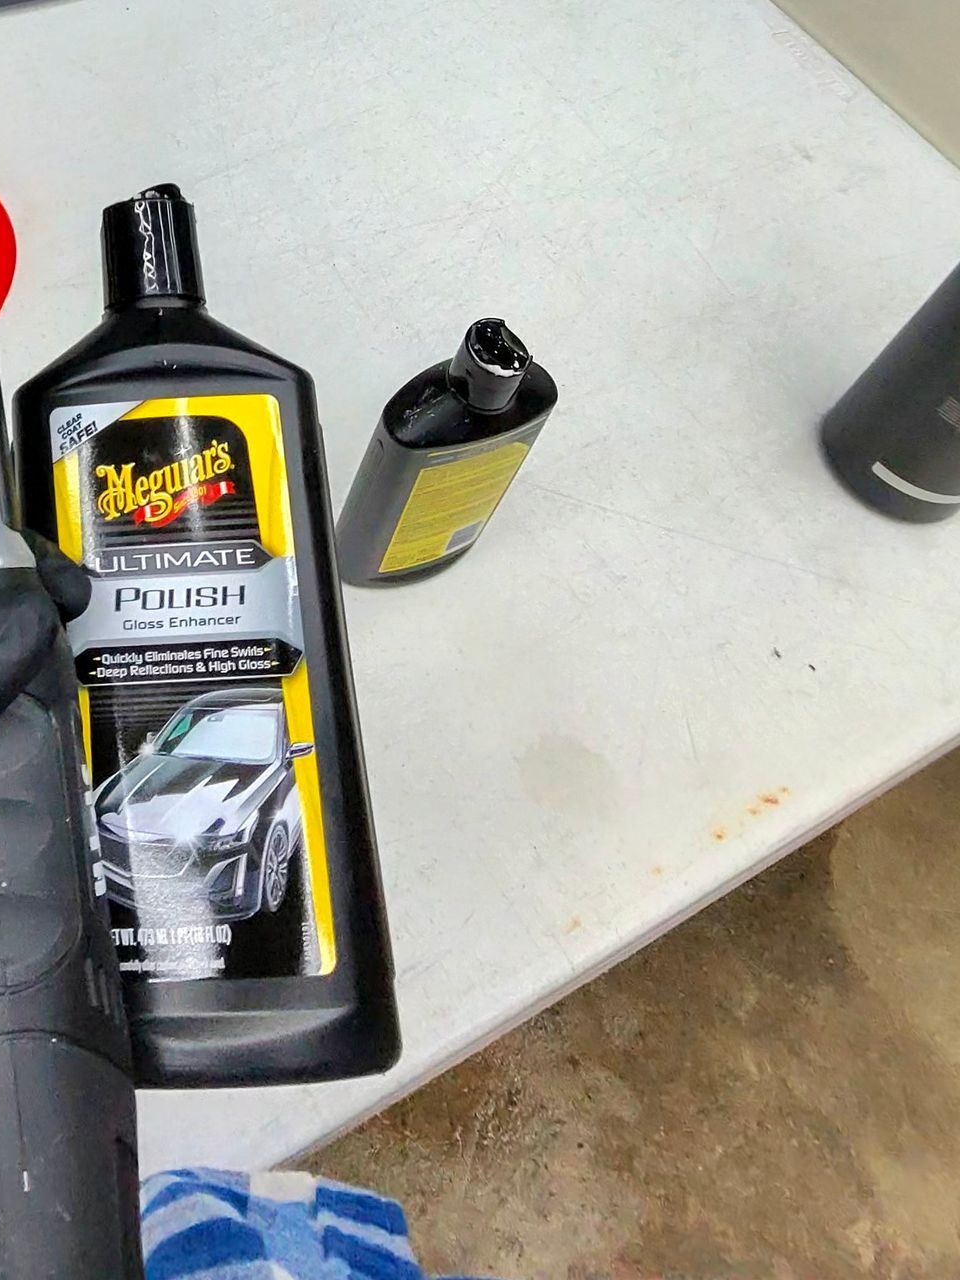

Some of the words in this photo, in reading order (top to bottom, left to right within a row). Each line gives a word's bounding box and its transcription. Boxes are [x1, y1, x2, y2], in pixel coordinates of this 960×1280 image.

[56, 412, 83, 435] CLEAR
[61, 421, 82, 440] COAT
[59, 420, 98, 455] SAFE!
[95, 439, 232, 523] Meguiar's
[94, 547, 256, 574] ULTIMATE
[123, 618, 165, 631] Gloss
[169, 615, 242, 628] Enhancer
[101, 652, 143, 666] Quickly
[144, 650, 202, 663] Eliminates
[203, 648, 229, 659] Fine
[231, 646, 264, 658] Swirls
[96, 667, 128, 680] Deep
[130, 663, 194, 677] Reflections
[195, 662, 207, 674] &
[208, 661, 237, 674] High
[239, 658, 272, 670] Gloss
